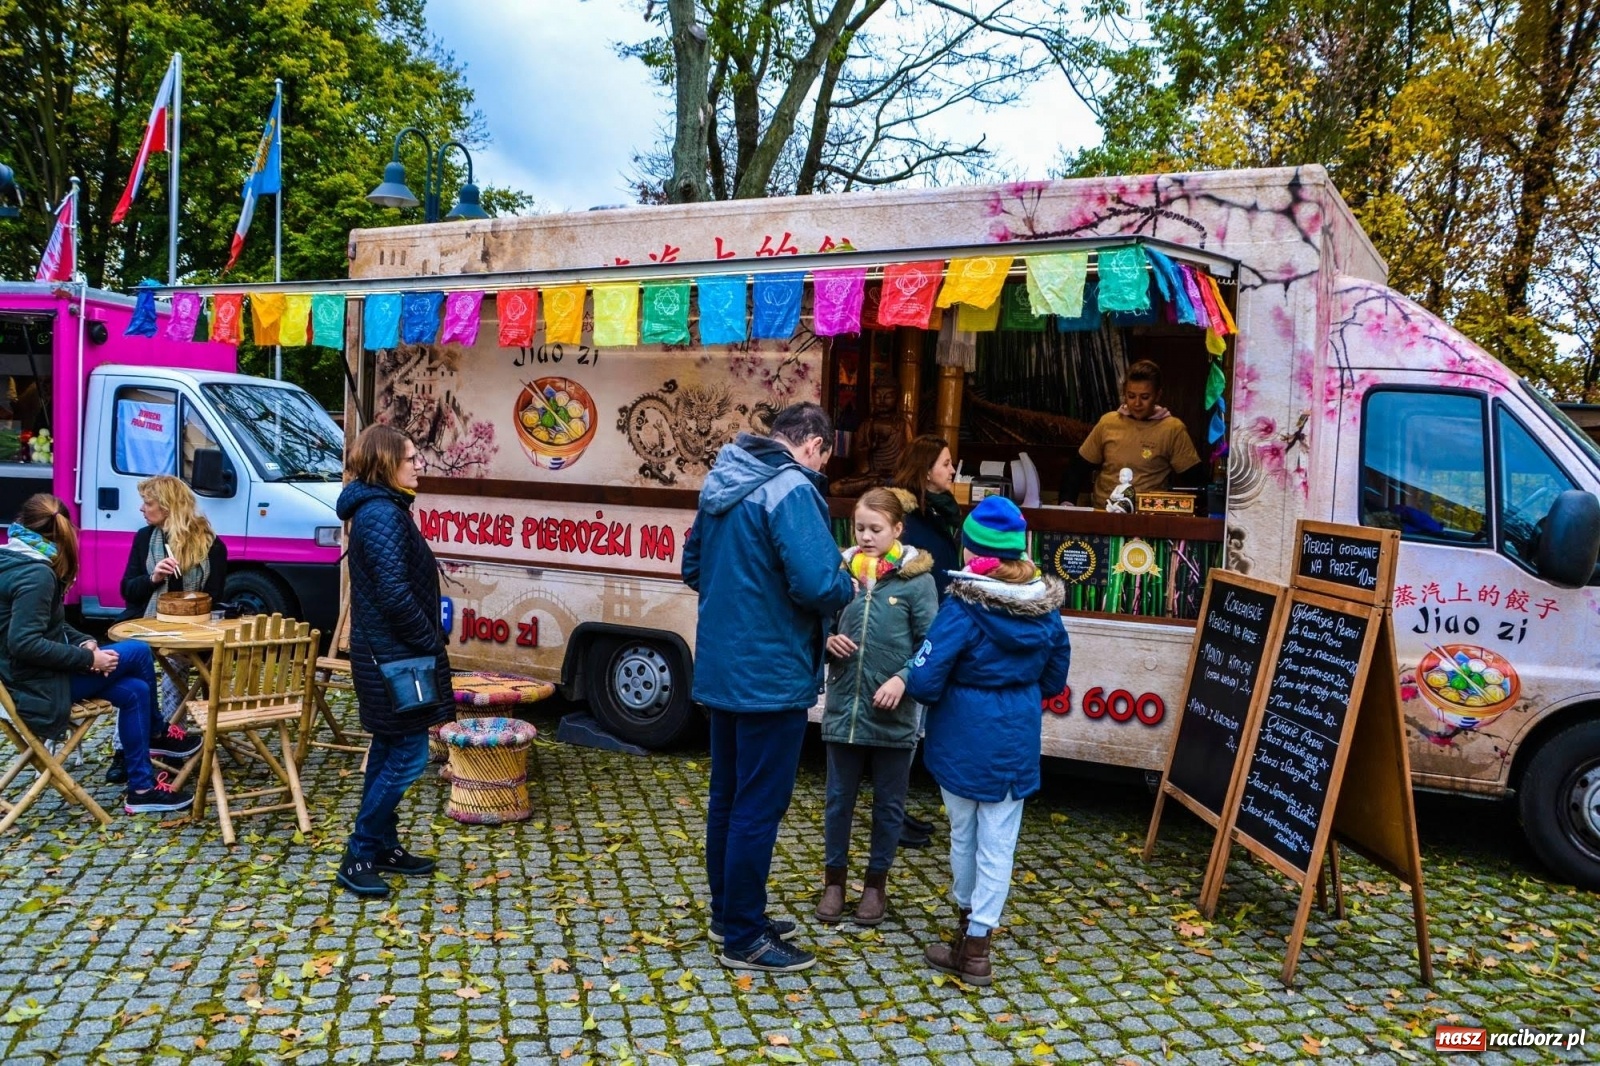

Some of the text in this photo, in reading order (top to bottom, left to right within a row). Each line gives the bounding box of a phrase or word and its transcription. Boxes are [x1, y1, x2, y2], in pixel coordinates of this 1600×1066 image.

[409, 508, 515, 547] JATYCKIE
[521, 510, 631, 557] PIEROŻKI
[639, 525, 675, 562] NA
[1339, 543, 1379, 559] GOTOWANE
[1310, 559, 1322, 574] NA
[1329, 558, 1359, 576] PARZE
[1393, 582, 1560, 620] 蒸汽上的餃子
[460, 607, 510, 643] jiao
[516, 616, 539, 647] zi
[1412, 606, 1528, 644] Jiao zi
[1082, 686, 1165, 725] 600
